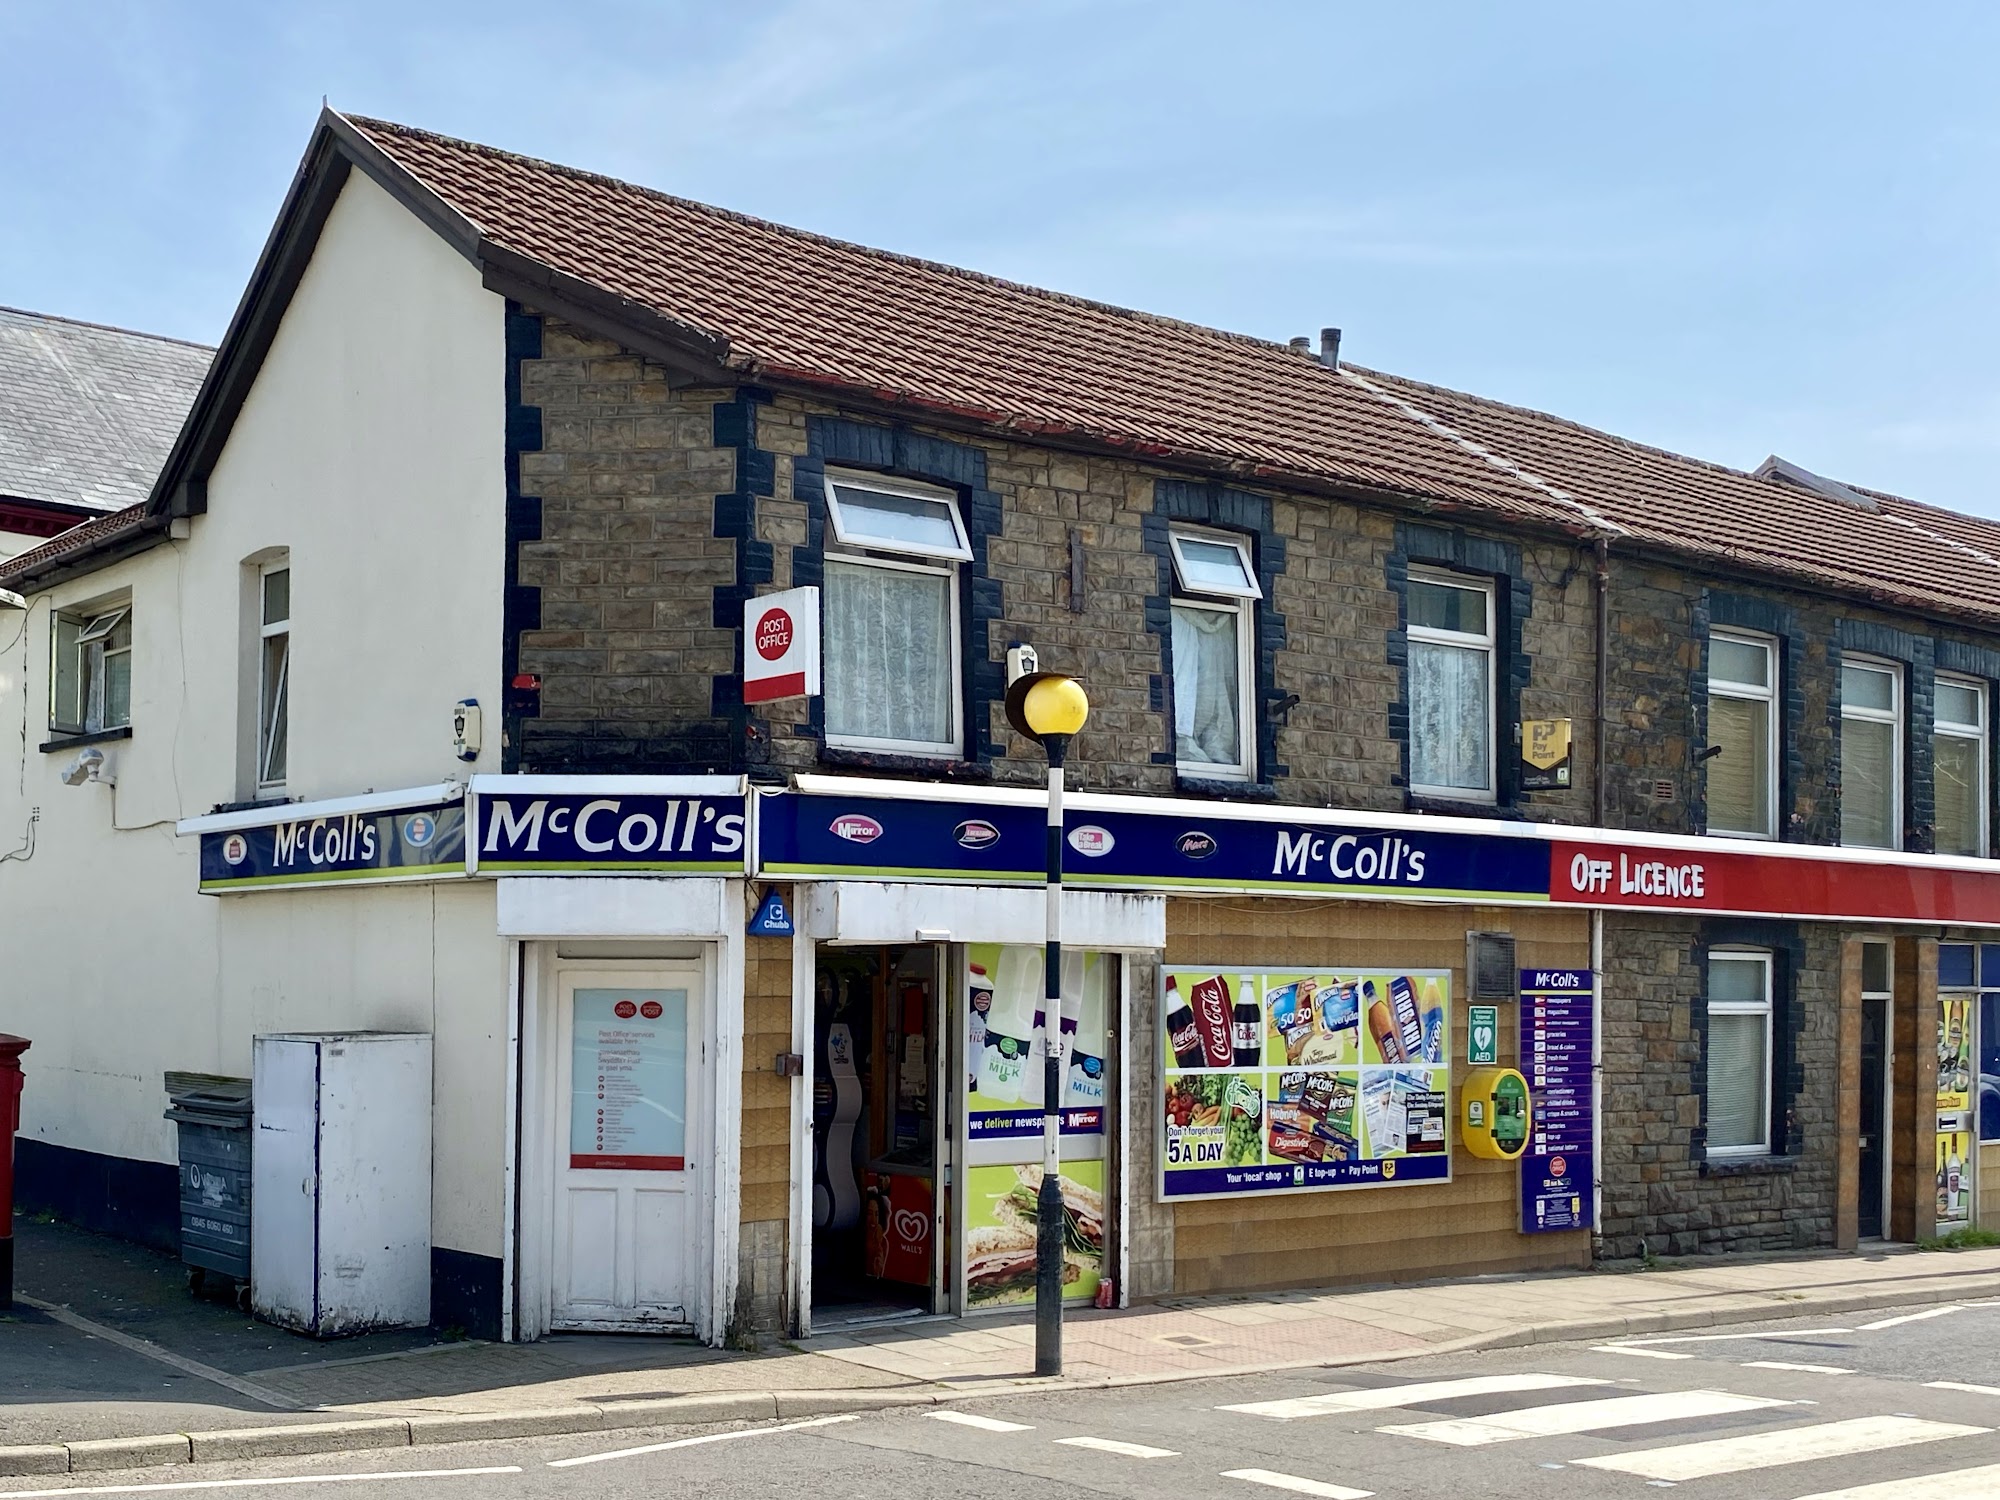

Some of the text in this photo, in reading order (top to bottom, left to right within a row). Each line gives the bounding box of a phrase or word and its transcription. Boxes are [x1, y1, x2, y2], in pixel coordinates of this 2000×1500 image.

[763, 617, 786, 635] POST
[758, 631, 789, 650] OFFICE
[1532, 742, 1548, 752] Pay
[1532, 751, 1555, 760] Point
[482, 799, 744, 853] McColl's
[838, 822, 875, 839] Mirror
[273, 813, 376, 867] McColl's
[1079, 831, 1095, 841] Take
[1084, 841, 1103, 850] Break
[1181, 838, 1209, 852] Mars
[1272, 830, 1426, 881] McColl's
[1570, 852, 1705, 898] OFF LICENCE
[763, 920, 790, 929] Chubb
[1535, 972, 1580, 987] McColl's
[1279, 1008, 1312, 1029] 50 50
[598, 1030, 612, 1038] Post
[1237, 1029, 1256, 1041] Coke
[1546, 1031, 1567, 1039] groceries
[1474, 1051, 1491, 1062] AED
[989, 1062, 1021, 1078] MILK
[1072, 1081, 1102, 1098] MILK
[969, 1113, 1098, 1130] we deliver newsps Mirror
[1168, 1126, 1224, 1137] Don't forget your
[1275, 1136, 1309, 1149] Digestives
[1168, 1138, 1224, 1163] 5 A DAY
[1227, 1173, 1242, 1184] Your
[1265, 1172, 1282, 1183] shop
[1308, 1169, 1314, 1178] E
[1314, 1168, 1337, 1179] top-up
[1349, 1166, 1361, 1177] Pay
[1361, 1164, 1379, 1175] Point
[900, 1243, 923, 1255] WALL'S
